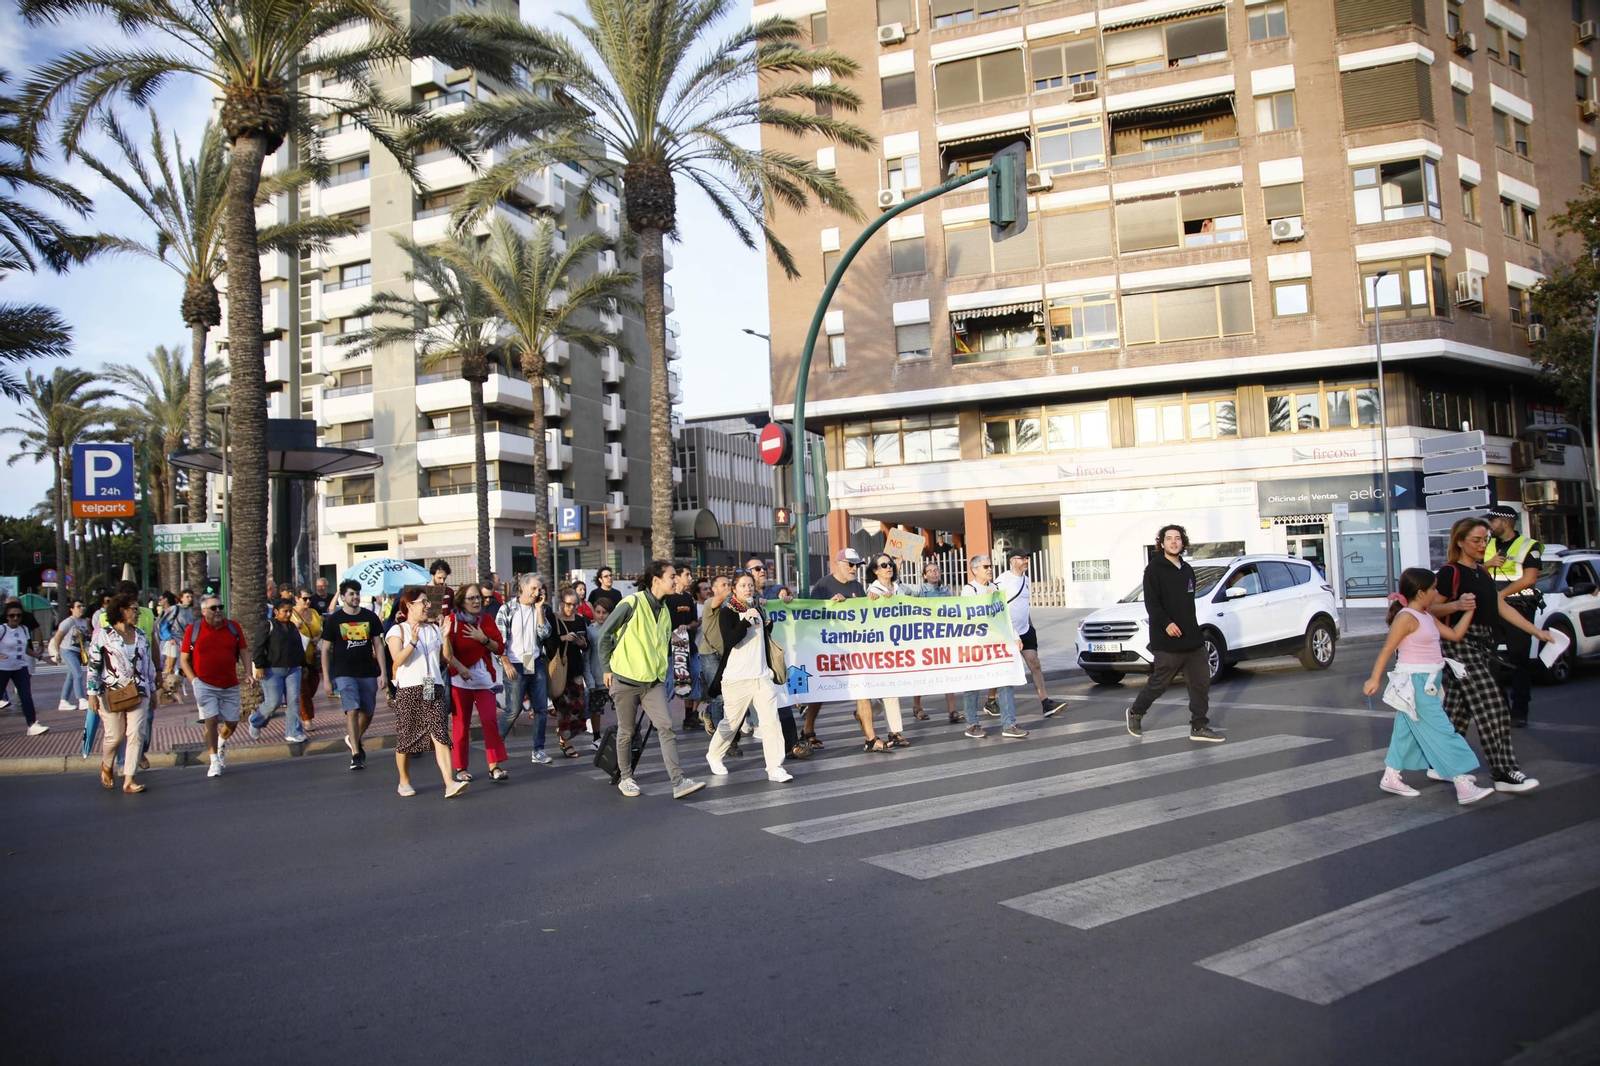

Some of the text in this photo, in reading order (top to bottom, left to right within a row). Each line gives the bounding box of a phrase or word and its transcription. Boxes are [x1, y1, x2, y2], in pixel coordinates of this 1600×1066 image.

[1312, 447, 1357, 460] fircosa
[85, 450, 121, 496] P
[1076, 465, 1115, 477] fircosa
[101, 487, 121, 496] 24h
[860, 482, 895, 493] fircosa
[1311, 492, 1338, 501] Ventas
[81, 503, 126, 515] telpark
[564, 508, 575, 526] P
[889, 539, 902, 549] NO
[367, 566, 385, 588] SIN
[765, 600, 1004, 624] os vecinos y vecinas del parque
[820, 622, 988, 646] también QUEREMOS
[816, 643, 1013, 672] GENOVESES SIN HOTEL
[863, 680, 886, 688] Vecinal
[897, 679, 912, 687] San
[945, 675, 962, 683] Pozo
[963, 673, 973, 681] de
[987, 668, 1013, 679] Frailes
